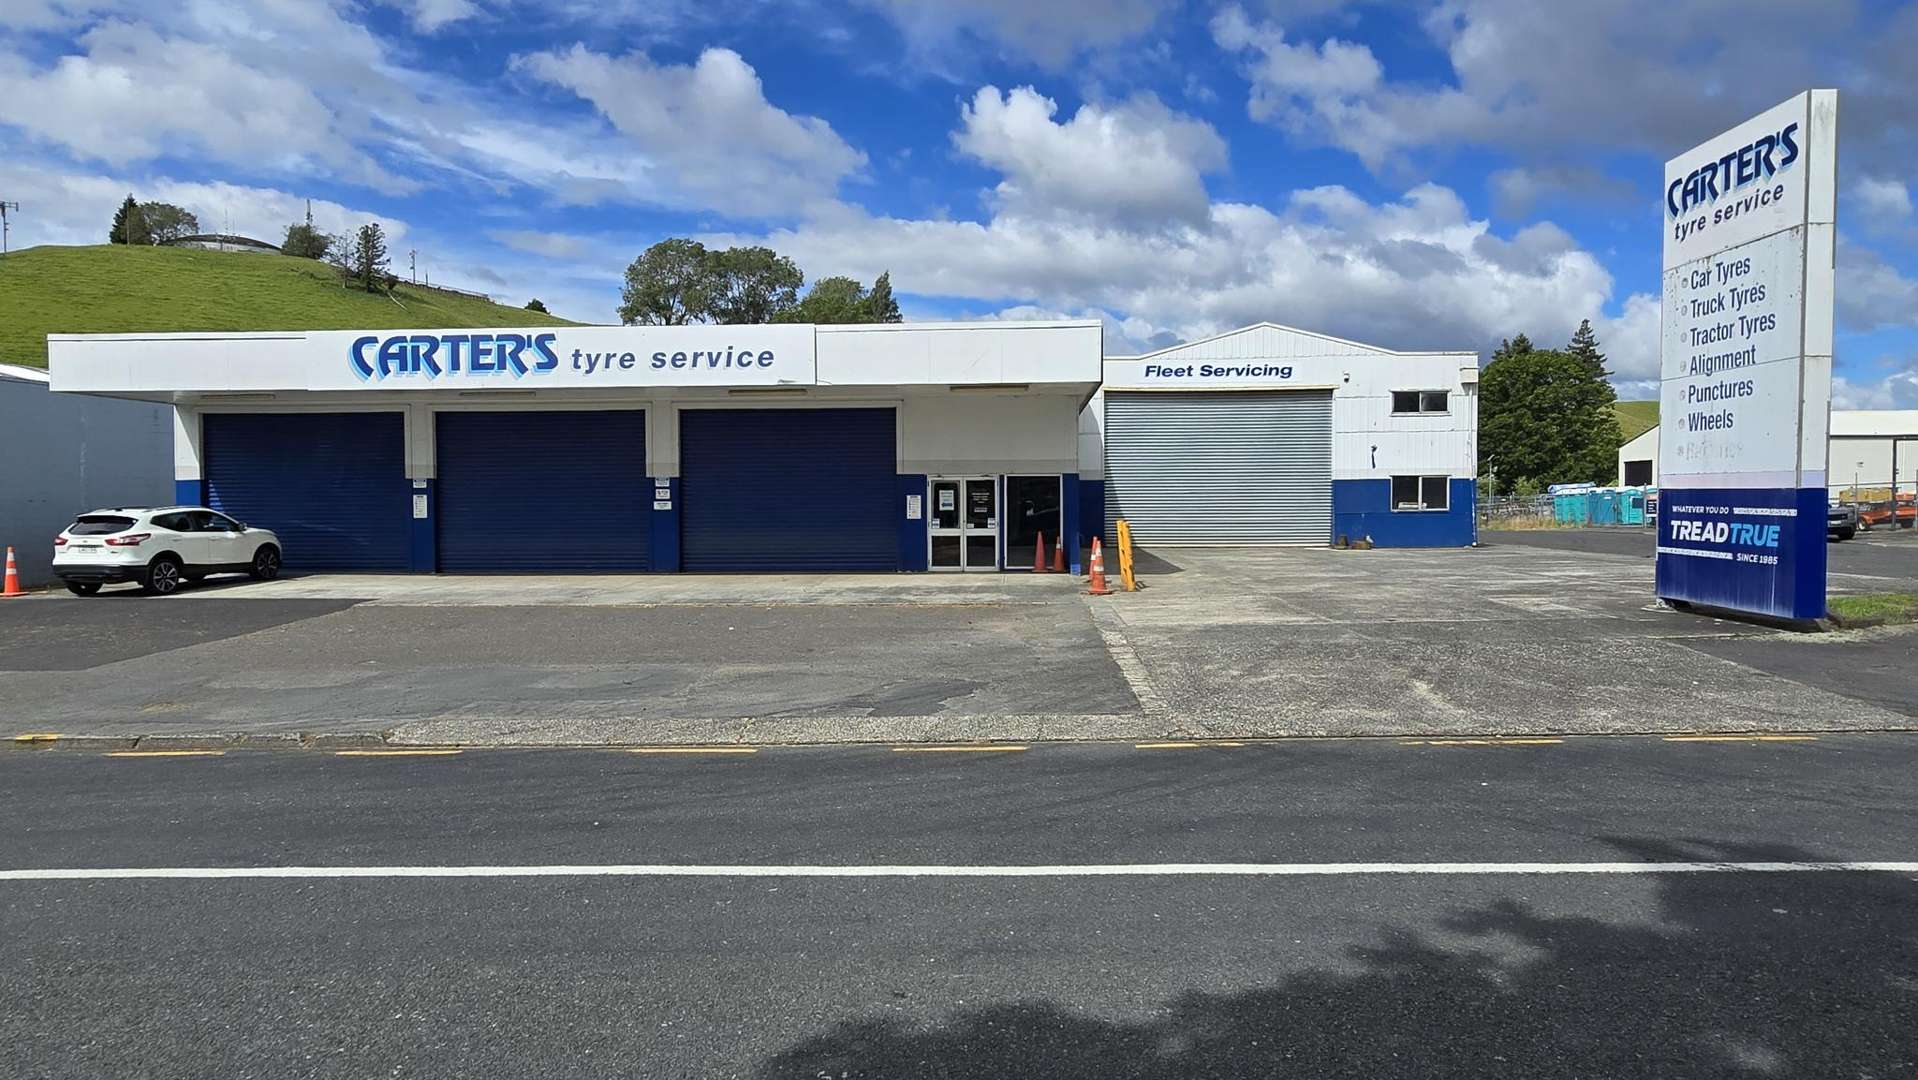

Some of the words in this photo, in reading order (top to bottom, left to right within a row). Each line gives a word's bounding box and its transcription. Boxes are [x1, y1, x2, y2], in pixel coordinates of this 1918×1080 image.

[1667, 122, 1798, 221] CARTER'S
[1675, 215, 1706, 242] tyre
[1714, 184, 1784, 225] service
[1691, 268, 1712, 290] Car
[1716, 257, 1751, 285] Tyres
[1691, 292, 1725, 318] Truck
[1729, 284, 1766, 311] Tyres
[1690, 321, 1734, 347] Tractor
[1739, 313, 1776, 340] Tyres
[348, 332, 559, 381] CARTER'S
[572, 347, 636, 375] tyre
[651, 345, 775, 369] service
[1145, 364, 1193, 378] Fleet
[1199, 363, 1293, 379] Servicing
[1689, 345, 1756, 376] Alignment
[1688, 379, 1753, 404] Punctures
[1688, 409, 1733, 432] Wheels
[1672, 505, 1704, 514] WHATEVER
[1706, 506, 1719, 514] YOU
[1719, 506, 1729, 514] DO
[1736, 552, 1758, 563] SINCE
[1759, 554, 1778, 565] 1985
